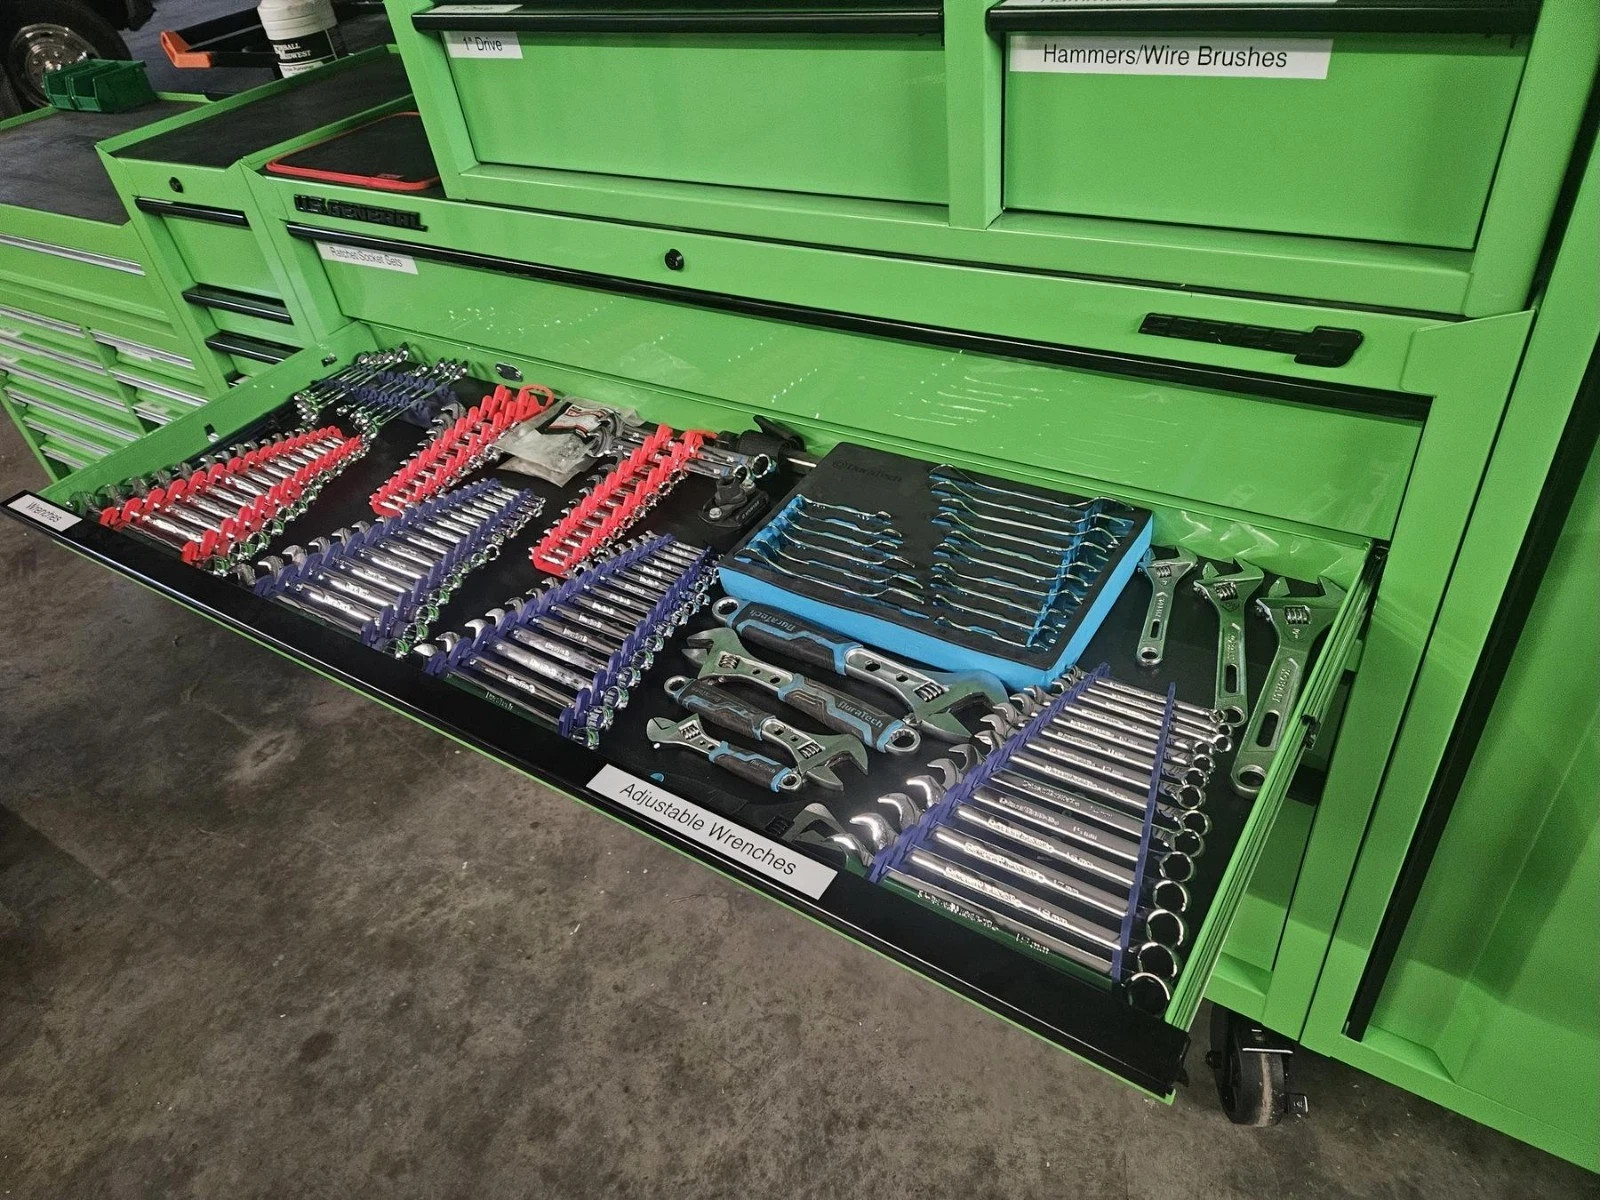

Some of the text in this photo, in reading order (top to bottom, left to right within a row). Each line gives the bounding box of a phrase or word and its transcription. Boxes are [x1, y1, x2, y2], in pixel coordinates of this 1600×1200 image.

[463, 36, 502, 51] 1" Drive
[1043, 43, 1288, 68] Hammers/Wire Brushes
[384, 253, 403, 268] Sets
[26, 501, 61, 523] Wrenches
[619, 782, 797, 875] Adjustable Wrenches
